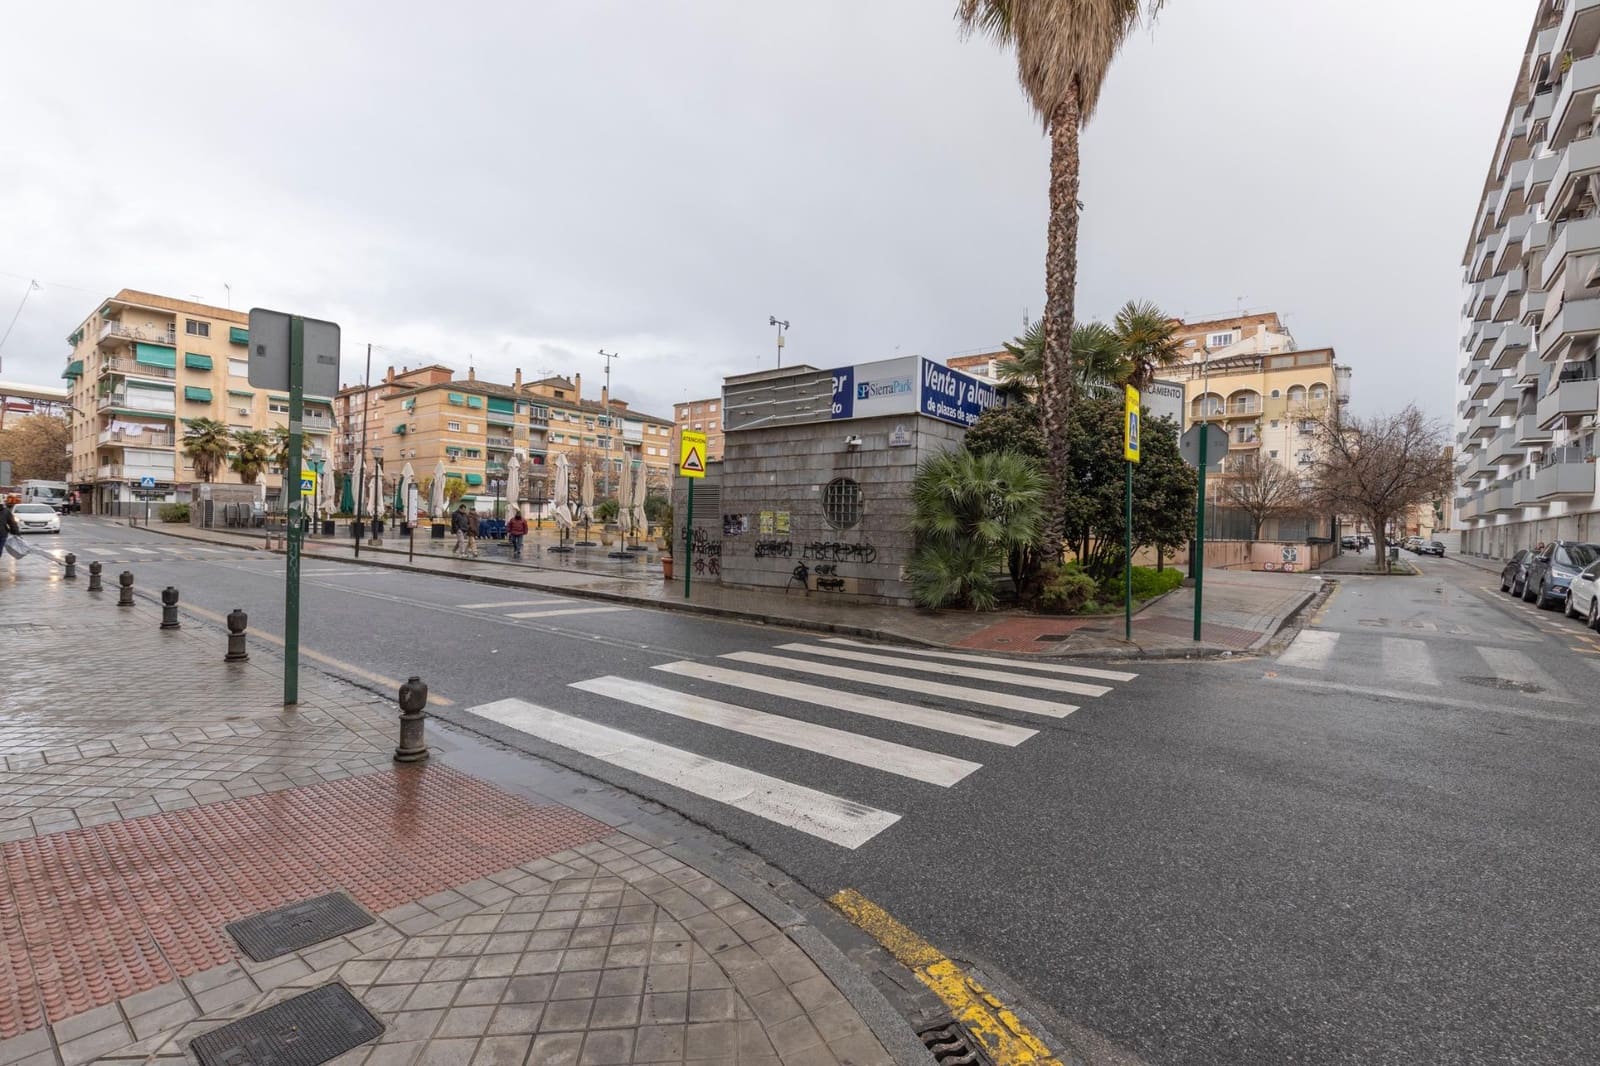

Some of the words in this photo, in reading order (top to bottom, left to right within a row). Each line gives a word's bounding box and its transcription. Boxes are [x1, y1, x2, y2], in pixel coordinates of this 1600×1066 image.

[870, 379, 912, 397] SierraPark
[925, 360, 957, 397] Venta
[957, 380, 967, 406] y
[967, 380, 1005, 412] alquiler
[927, 396, 936, 412] de
[936, 400, 957, 417] plazas
[957, 406, 965, 421] de
